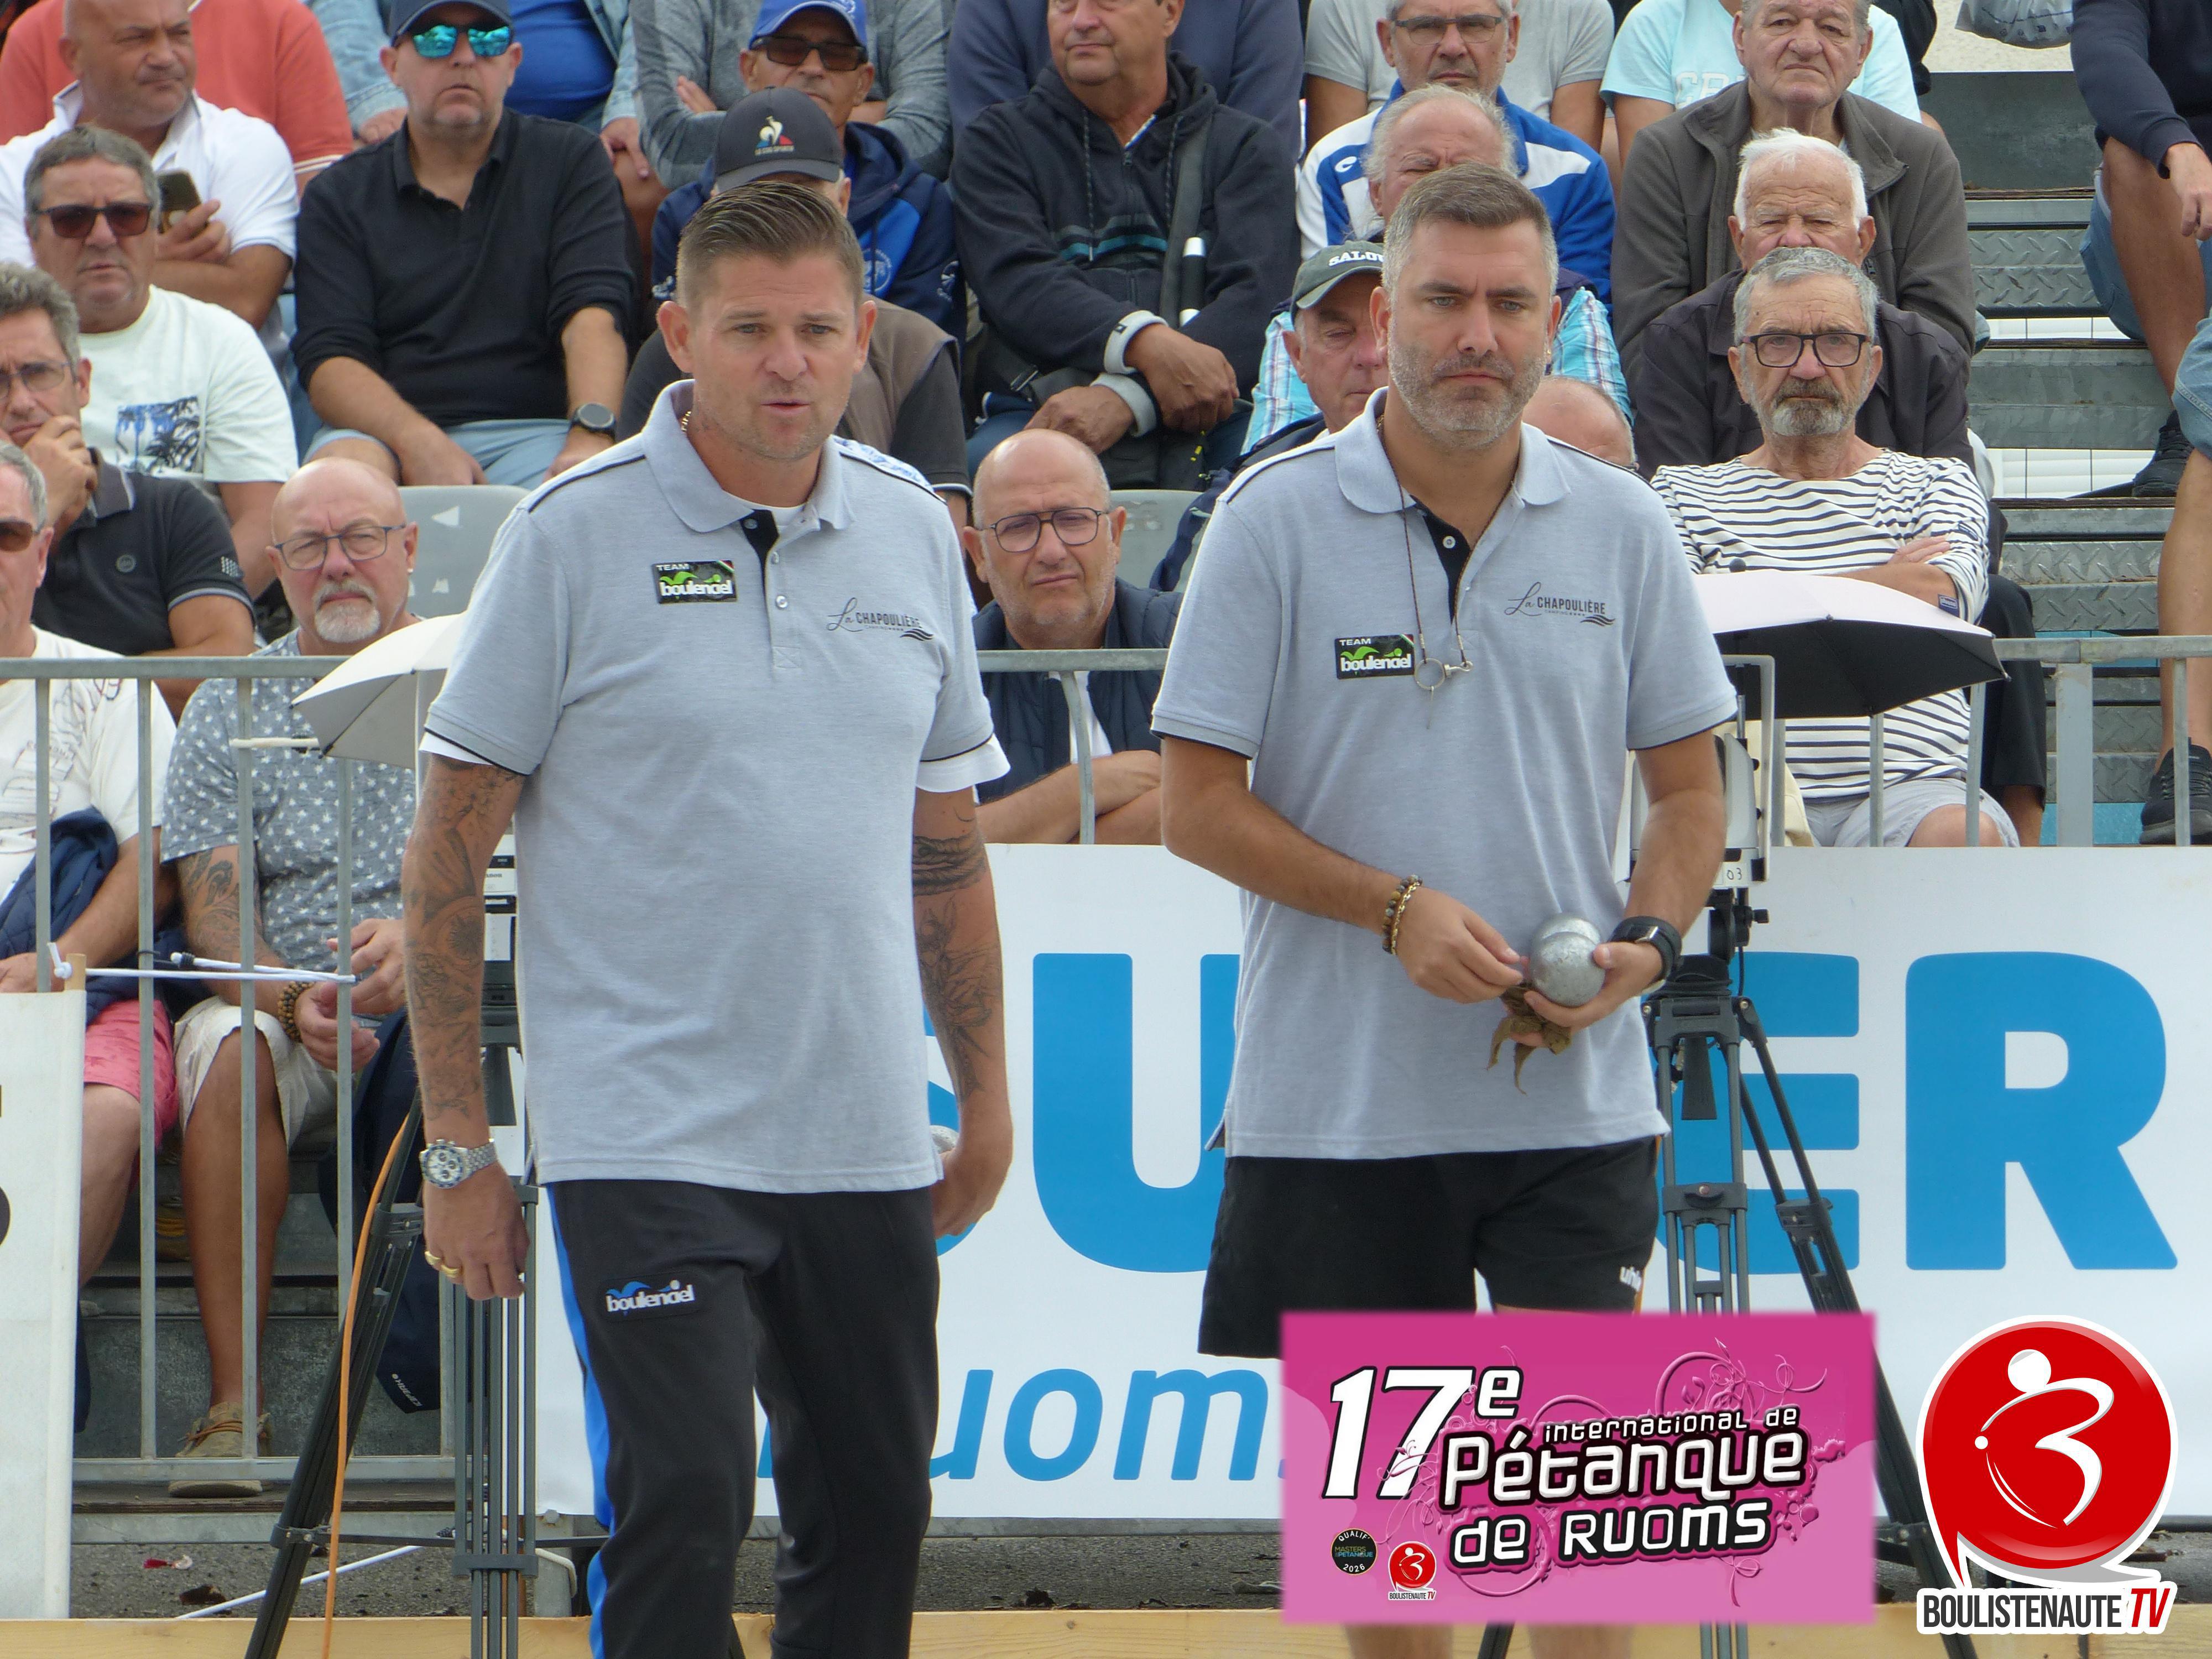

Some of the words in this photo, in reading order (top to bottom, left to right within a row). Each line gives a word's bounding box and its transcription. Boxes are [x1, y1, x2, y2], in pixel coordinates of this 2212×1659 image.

[1504, 582, 1542, 616] La
[1537, 597, 1605, 614] CHAPOULIÈRE
[1727, 868, 1742, 880] 03
